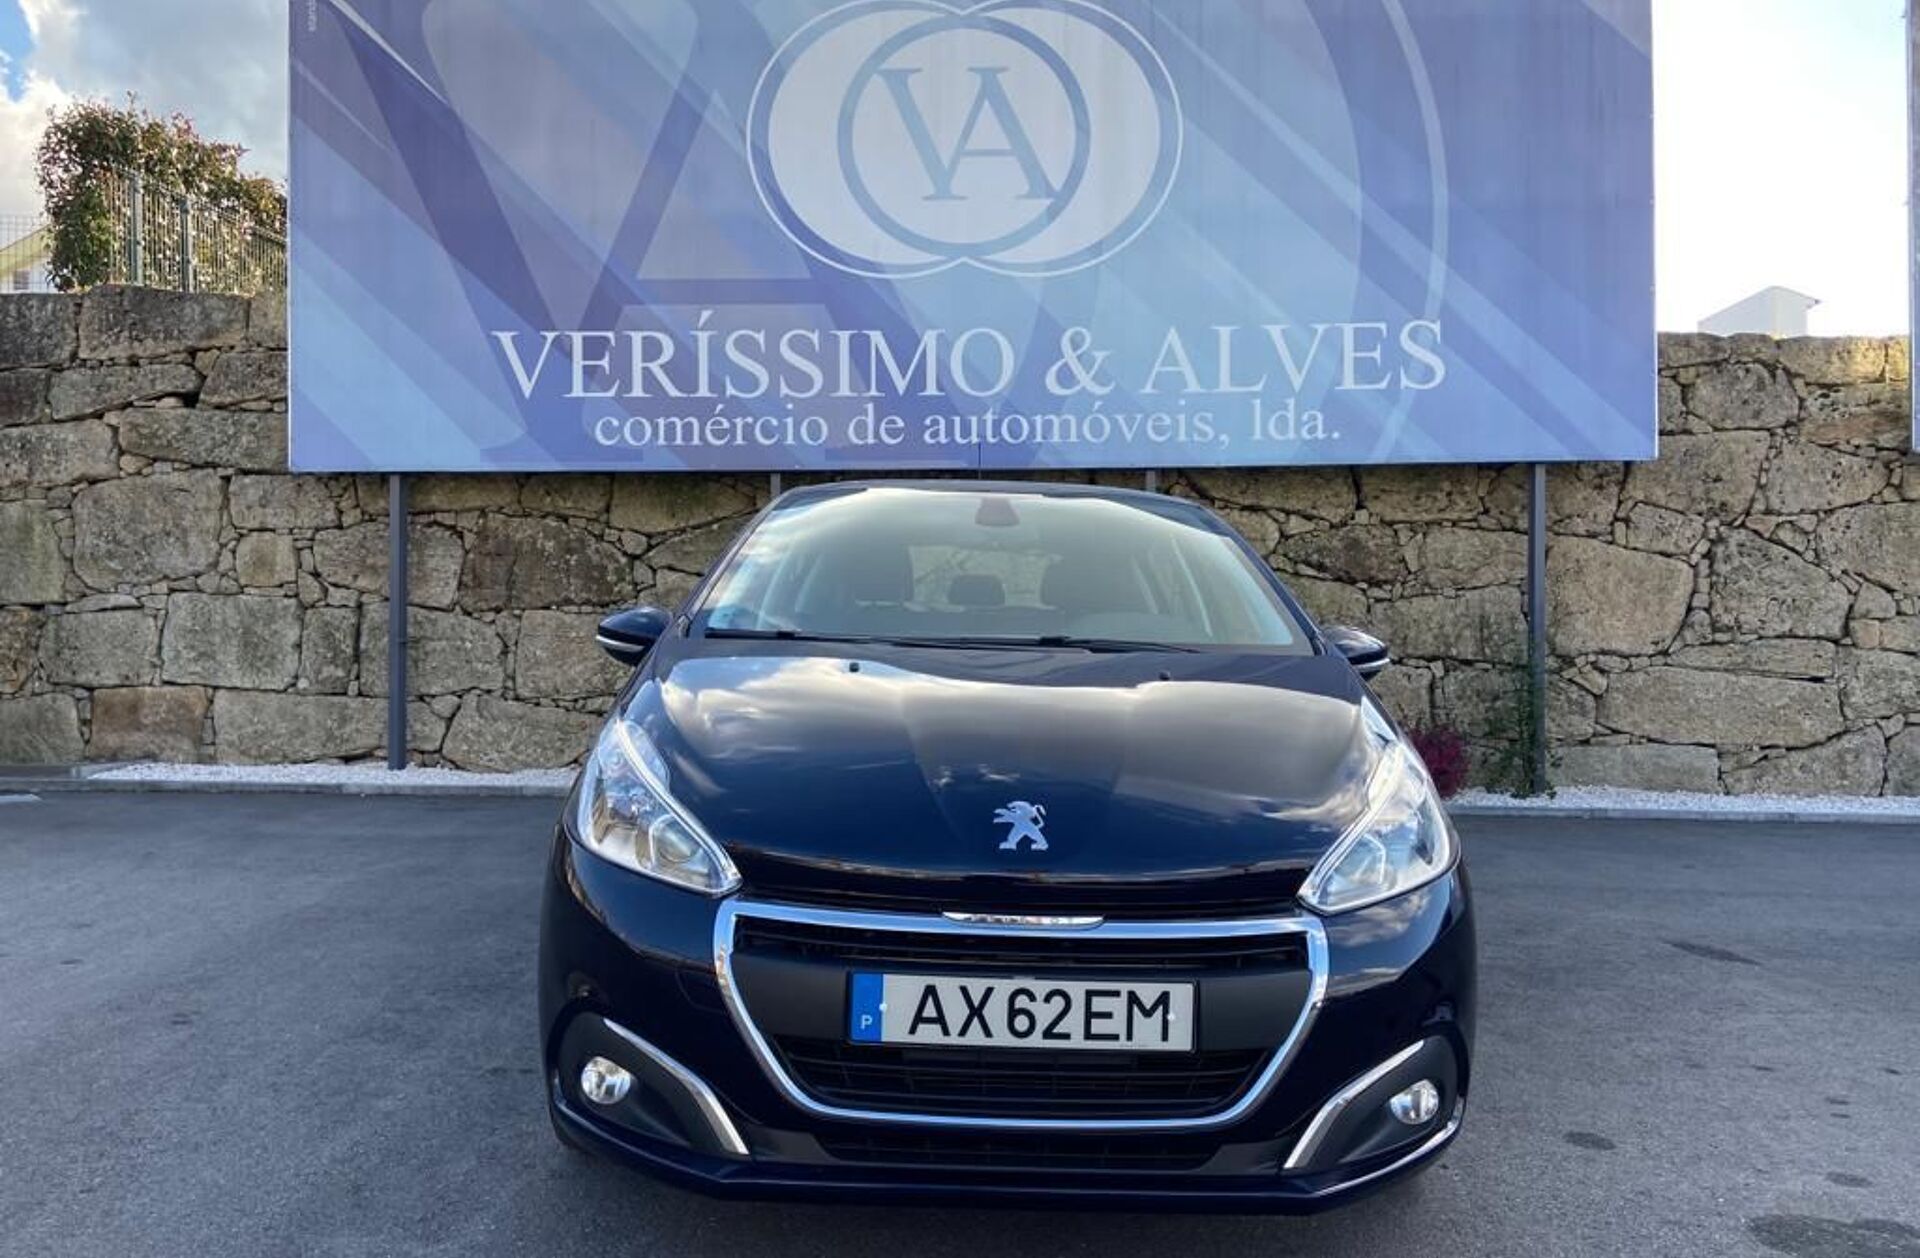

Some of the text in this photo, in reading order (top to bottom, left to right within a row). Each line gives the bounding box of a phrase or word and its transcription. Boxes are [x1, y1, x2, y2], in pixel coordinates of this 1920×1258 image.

[873, 67, 1062, 200] VA
[491, 310, 1447, 400] VERÍSSIMO & ALVES
[594, 398, 1342, 447] comércio de automóveis, lda.
[861, 1015, 872, 1029] P
